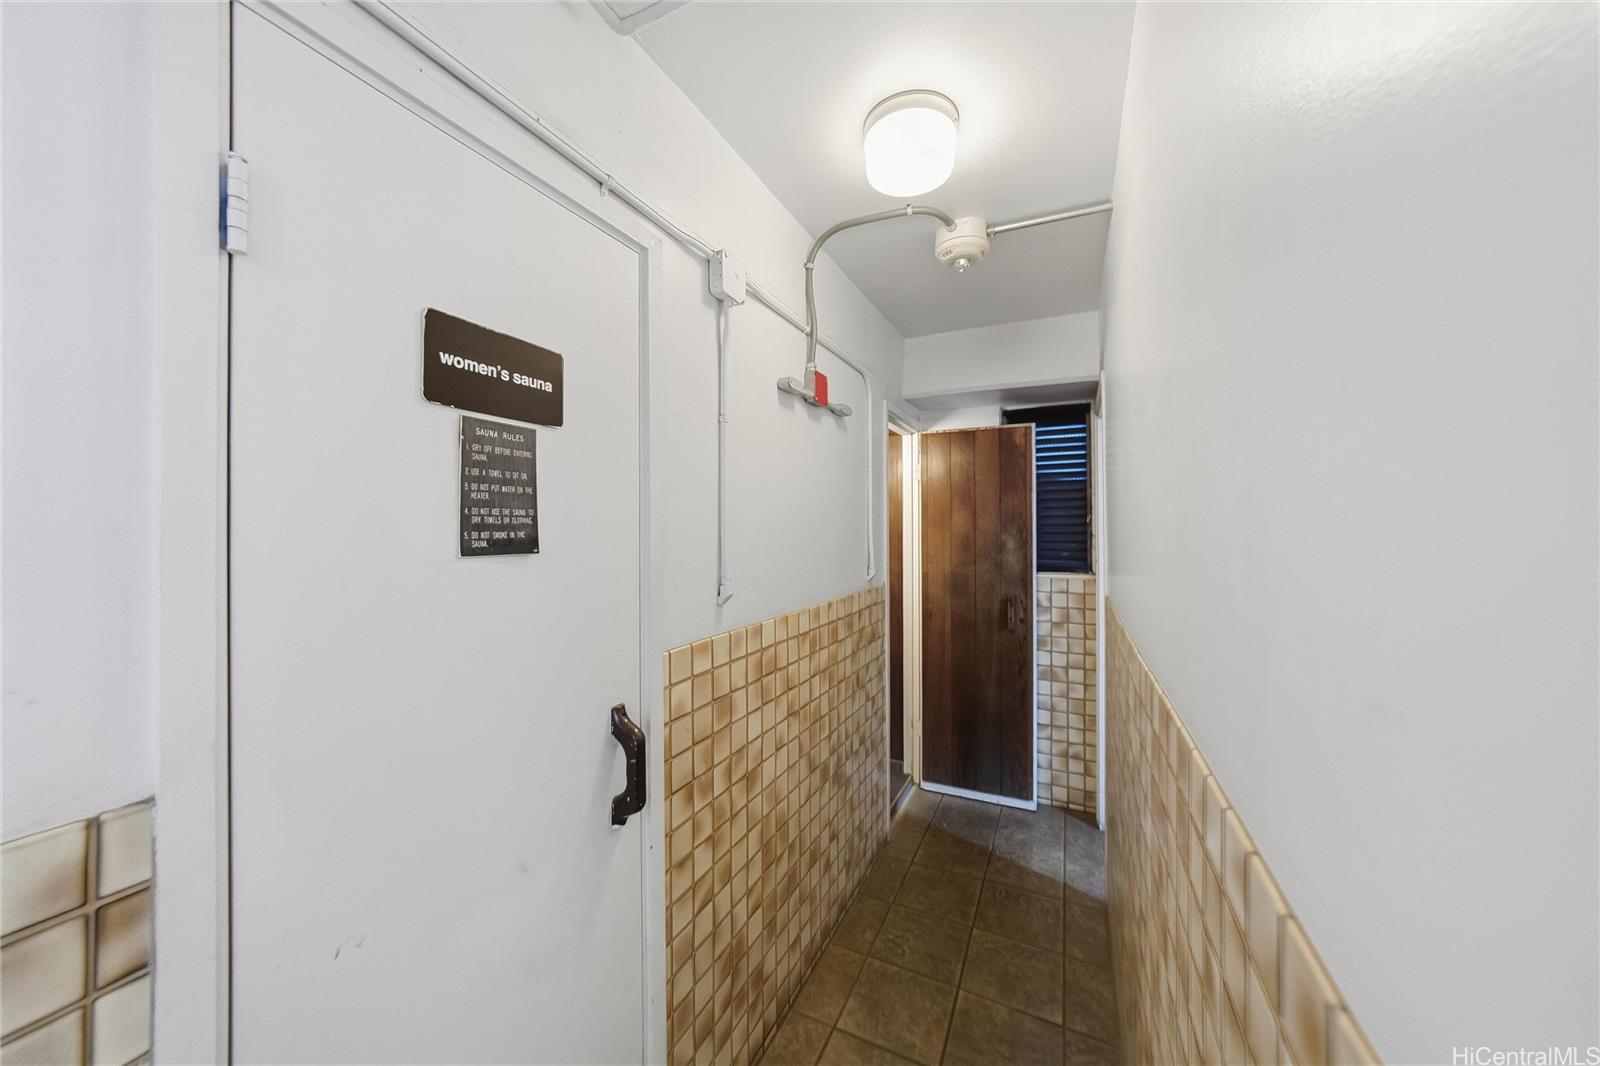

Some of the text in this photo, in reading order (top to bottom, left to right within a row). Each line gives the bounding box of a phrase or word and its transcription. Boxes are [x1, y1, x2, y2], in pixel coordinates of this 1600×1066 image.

[439, 352, 552, 392] women's sauna
[476, 427, 524, 442] SAUNA RULES
[495, 446, 511, 456] BEFORE
[471, 468, 480, 476] USE
[489, 469, 502, 478] TOWEL
[472, 516, 481, 524] DRY
